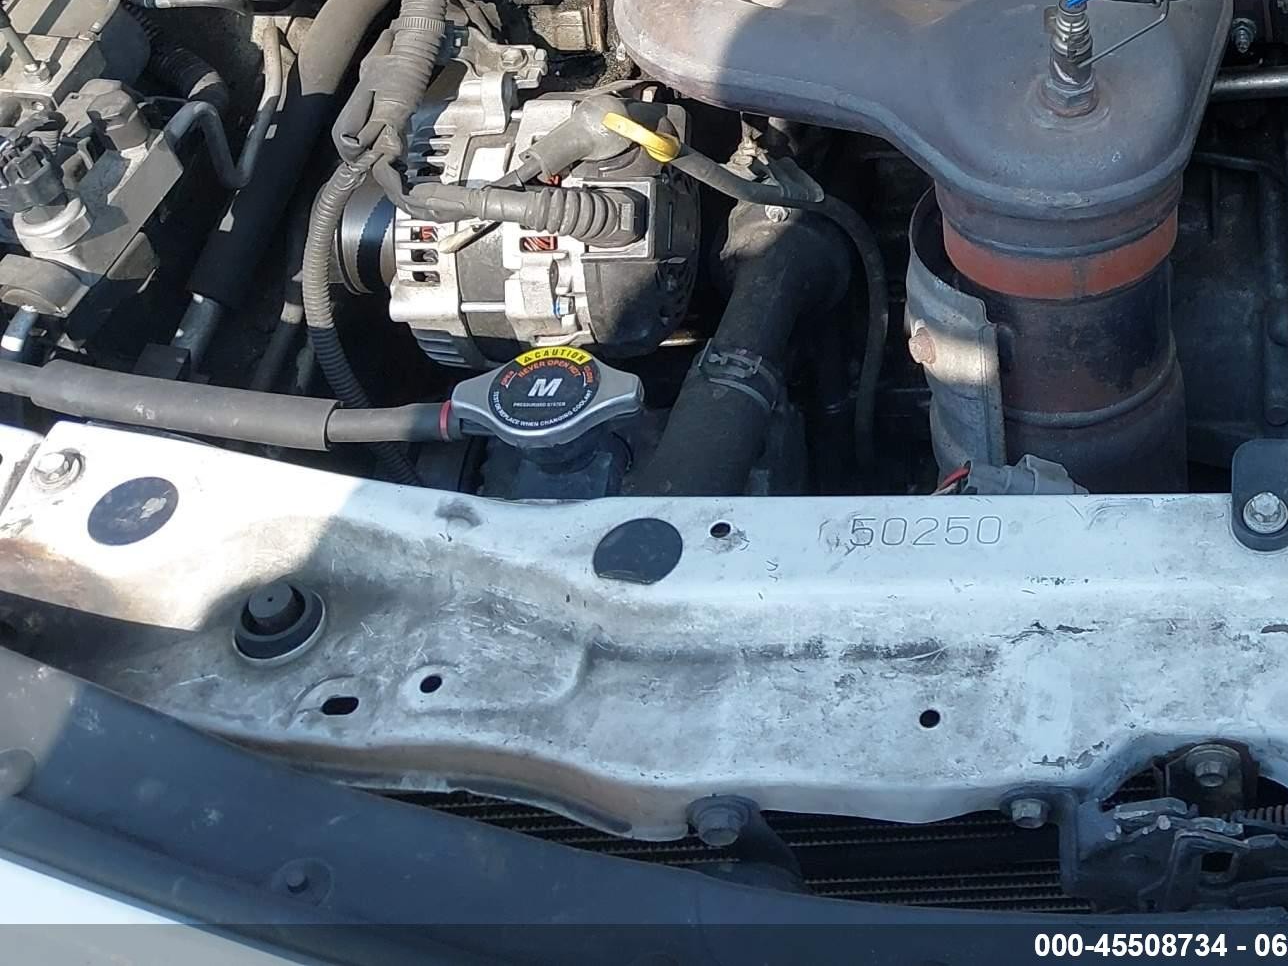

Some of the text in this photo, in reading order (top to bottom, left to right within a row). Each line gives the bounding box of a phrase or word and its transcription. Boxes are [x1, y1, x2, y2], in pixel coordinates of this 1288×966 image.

[534, 349, 587, 362] CAUTION
[528, 378, 564, 397] M
[540, 411, 573, 426] CHANGING
[572, 389, 593, 412] COOLANT
[850, 516, 1002, 546] 50250
